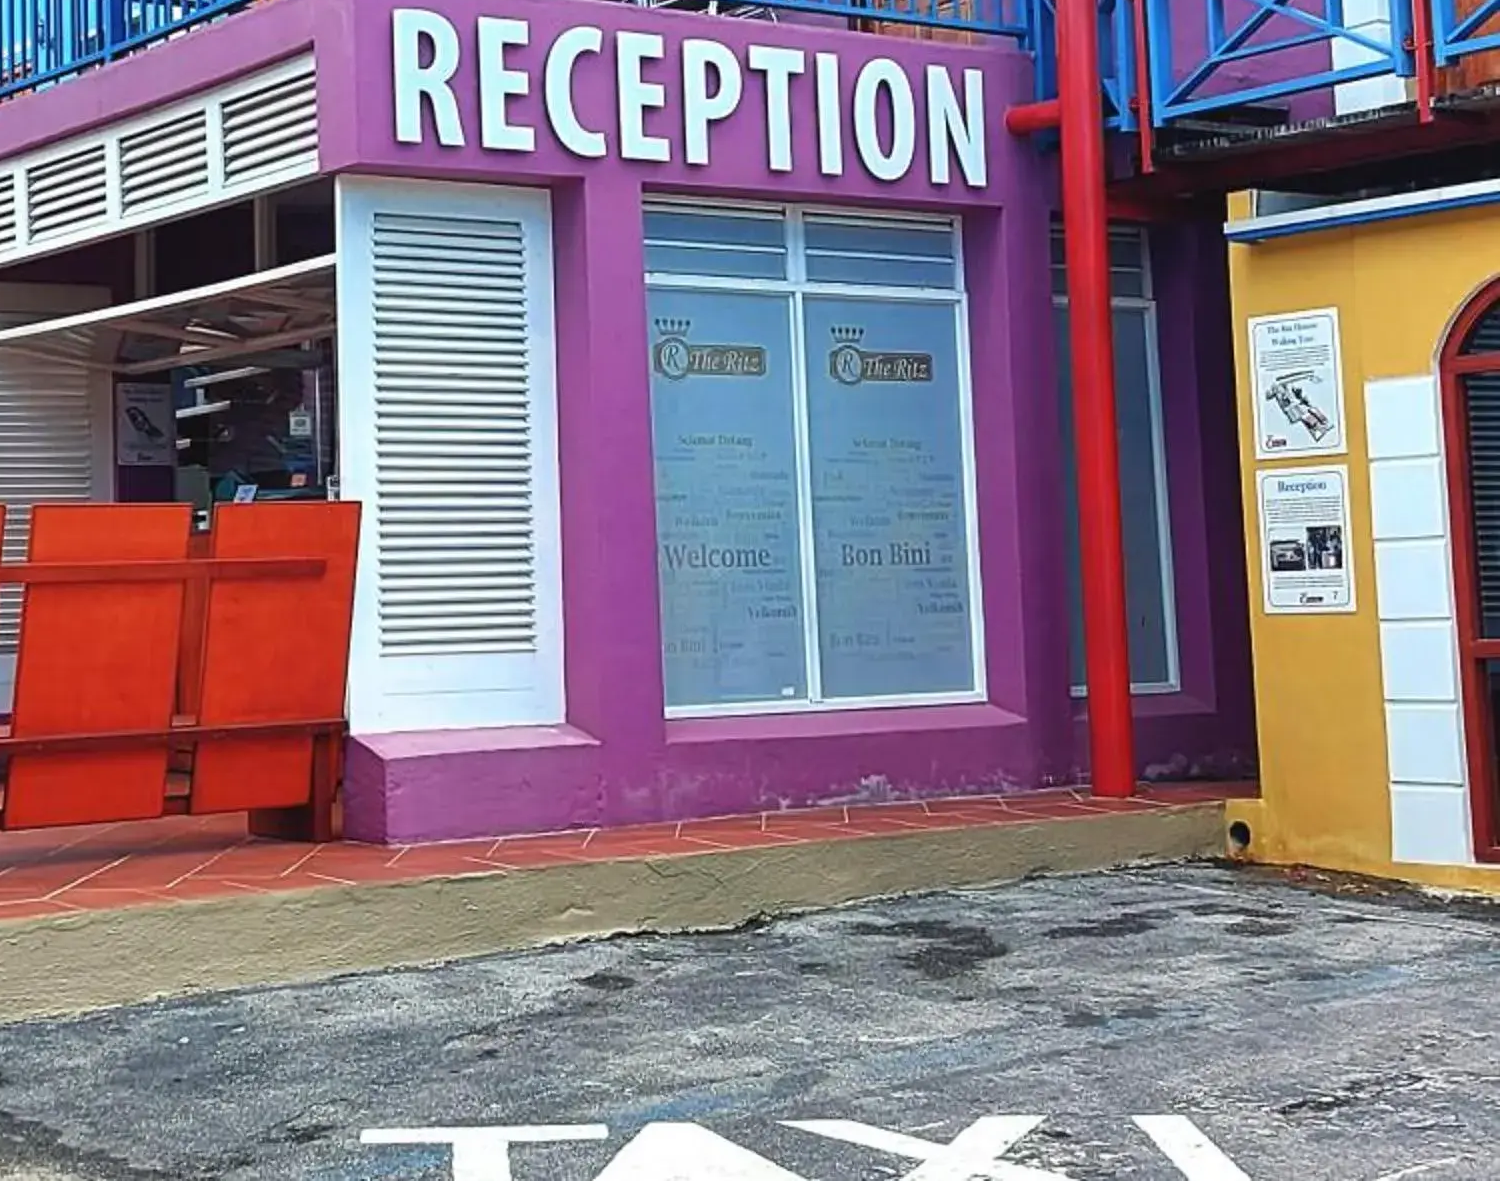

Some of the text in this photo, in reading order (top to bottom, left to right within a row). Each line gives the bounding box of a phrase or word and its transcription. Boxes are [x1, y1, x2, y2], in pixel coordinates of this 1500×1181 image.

[393, 8, 988, 188] RECEPTION
[689, 349, 760, 374] The Ritz
[863, 355, 928, 380] The Ritz
[1277, 480, 1328, 493] Reception
[663, 543, 772, 569] Welcome
[841, 543, 884, 566] Bon
[890, 541, 931, 566] Bini
